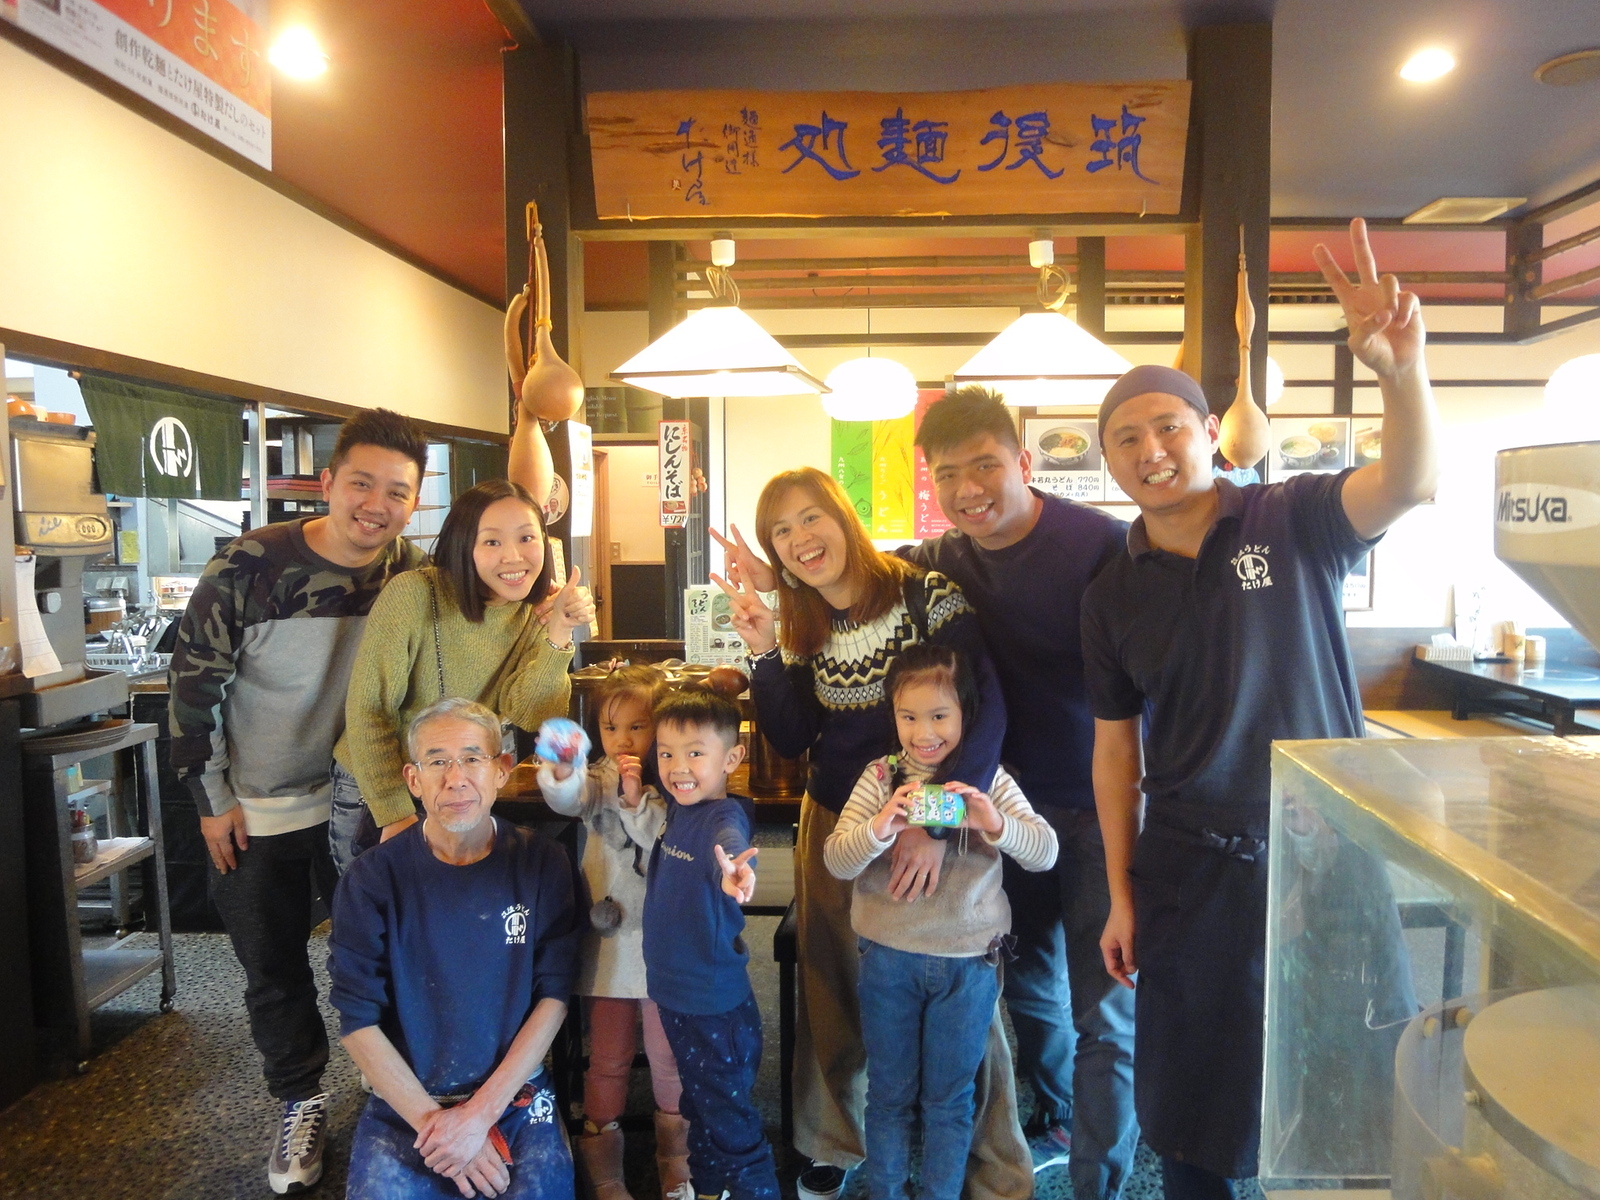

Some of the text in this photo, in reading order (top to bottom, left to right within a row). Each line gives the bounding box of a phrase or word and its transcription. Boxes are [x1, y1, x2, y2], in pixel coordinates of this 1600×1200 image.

[663, 424, 684, 500] にしんそば
